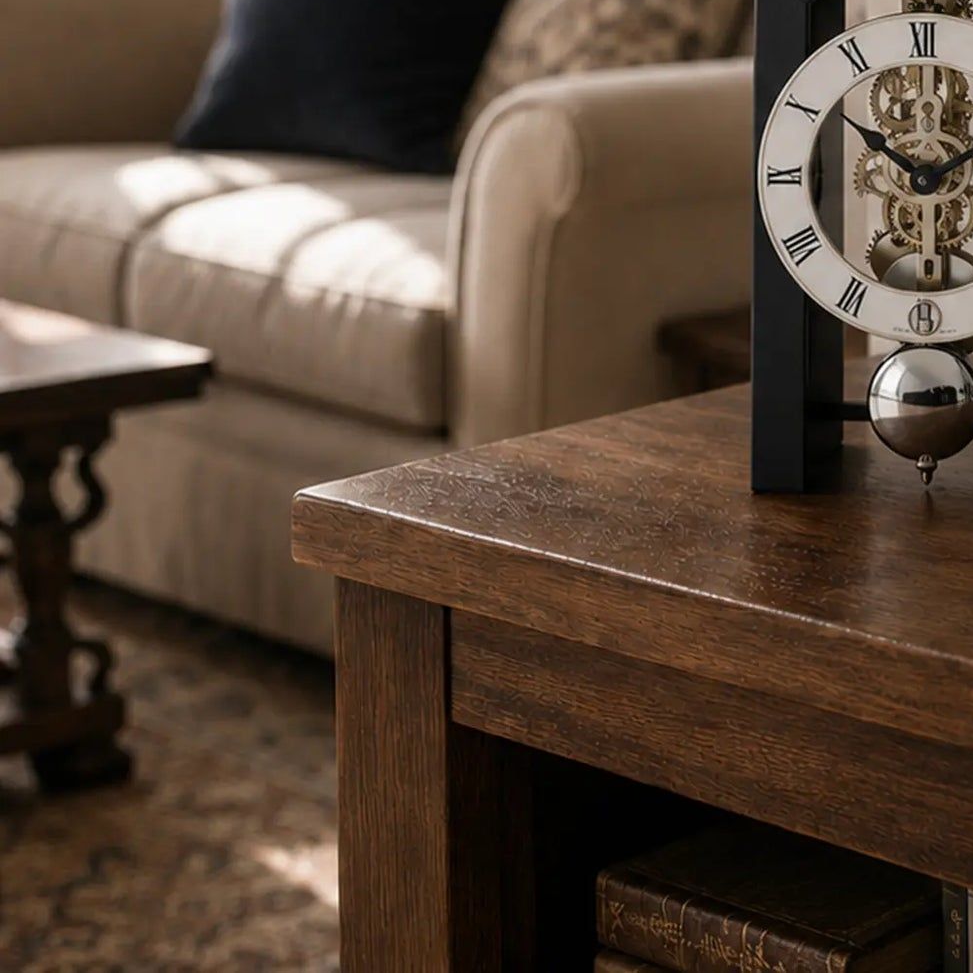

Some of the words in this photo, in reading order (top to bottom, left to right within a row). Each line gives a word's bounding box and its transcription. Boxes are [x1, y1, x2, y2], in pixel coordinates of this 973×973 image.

[837, 36, 870, 78] XI
[908, 21, 937, 58] XII
[784, 93, 821, 123] X
[767, 165, 802, 188] IX
[781, 224, 822, 267] VIII
[835, 275, 869, 319] VII
